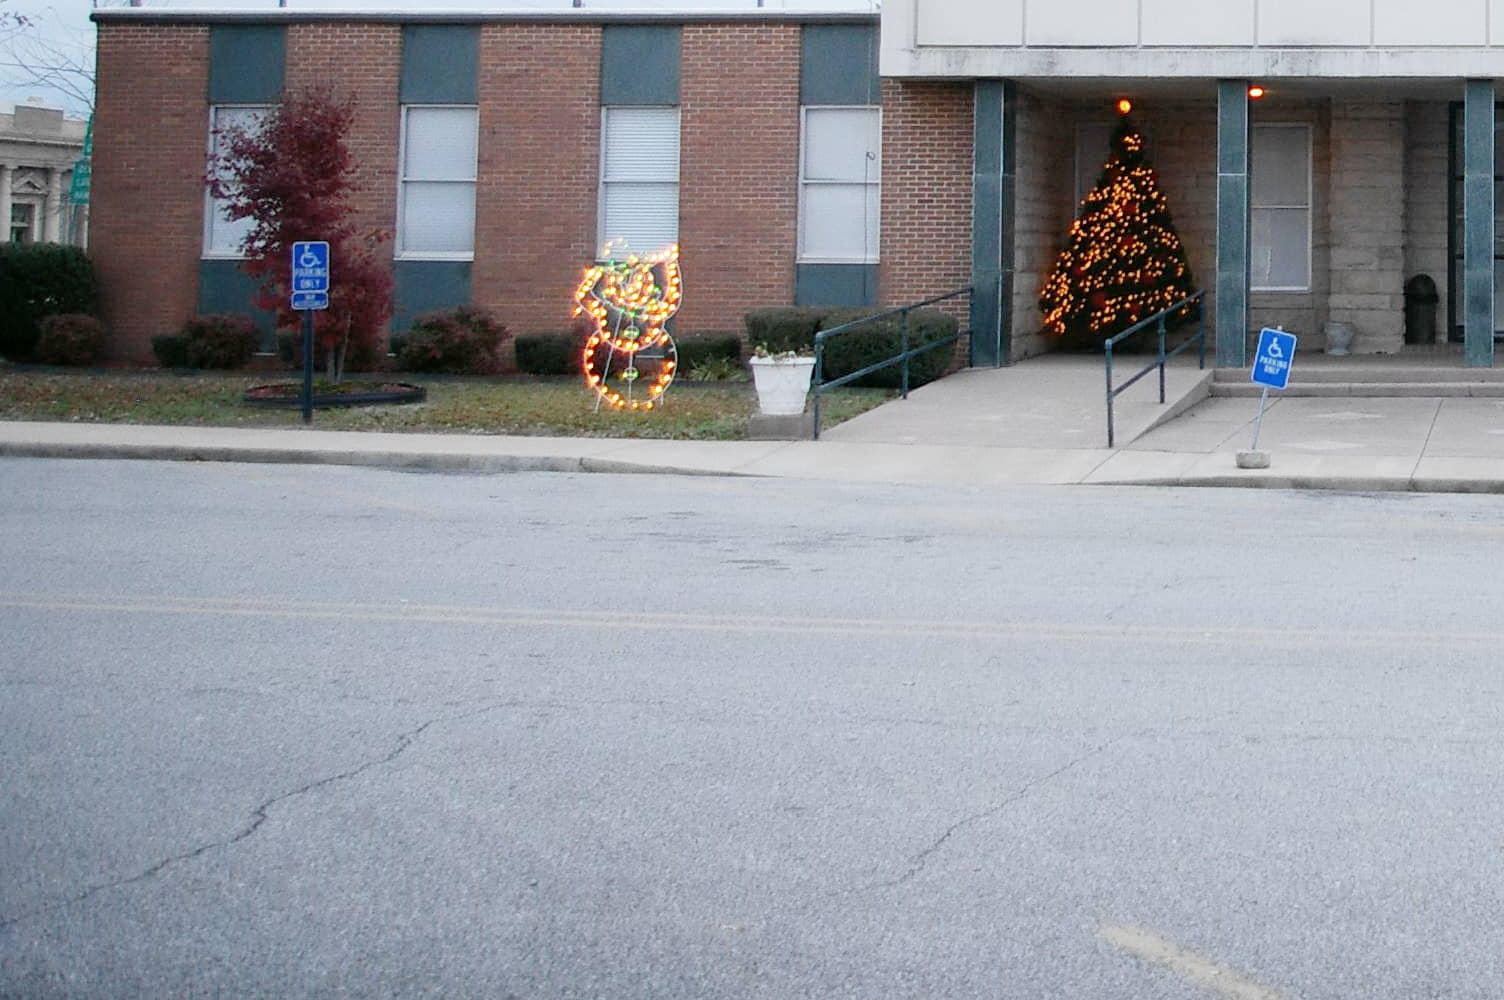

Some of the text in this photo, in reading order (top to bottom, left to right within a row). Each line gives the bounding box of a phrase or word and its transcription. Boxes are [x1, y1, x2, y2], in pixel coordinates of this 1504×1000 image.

[295, 268, 327, 277] PARKING
[300, 279, 320, 289] ONLY
[1259, 355, 1288, 370] PARKING
[1263, 365, 1280, 375] ONLY
